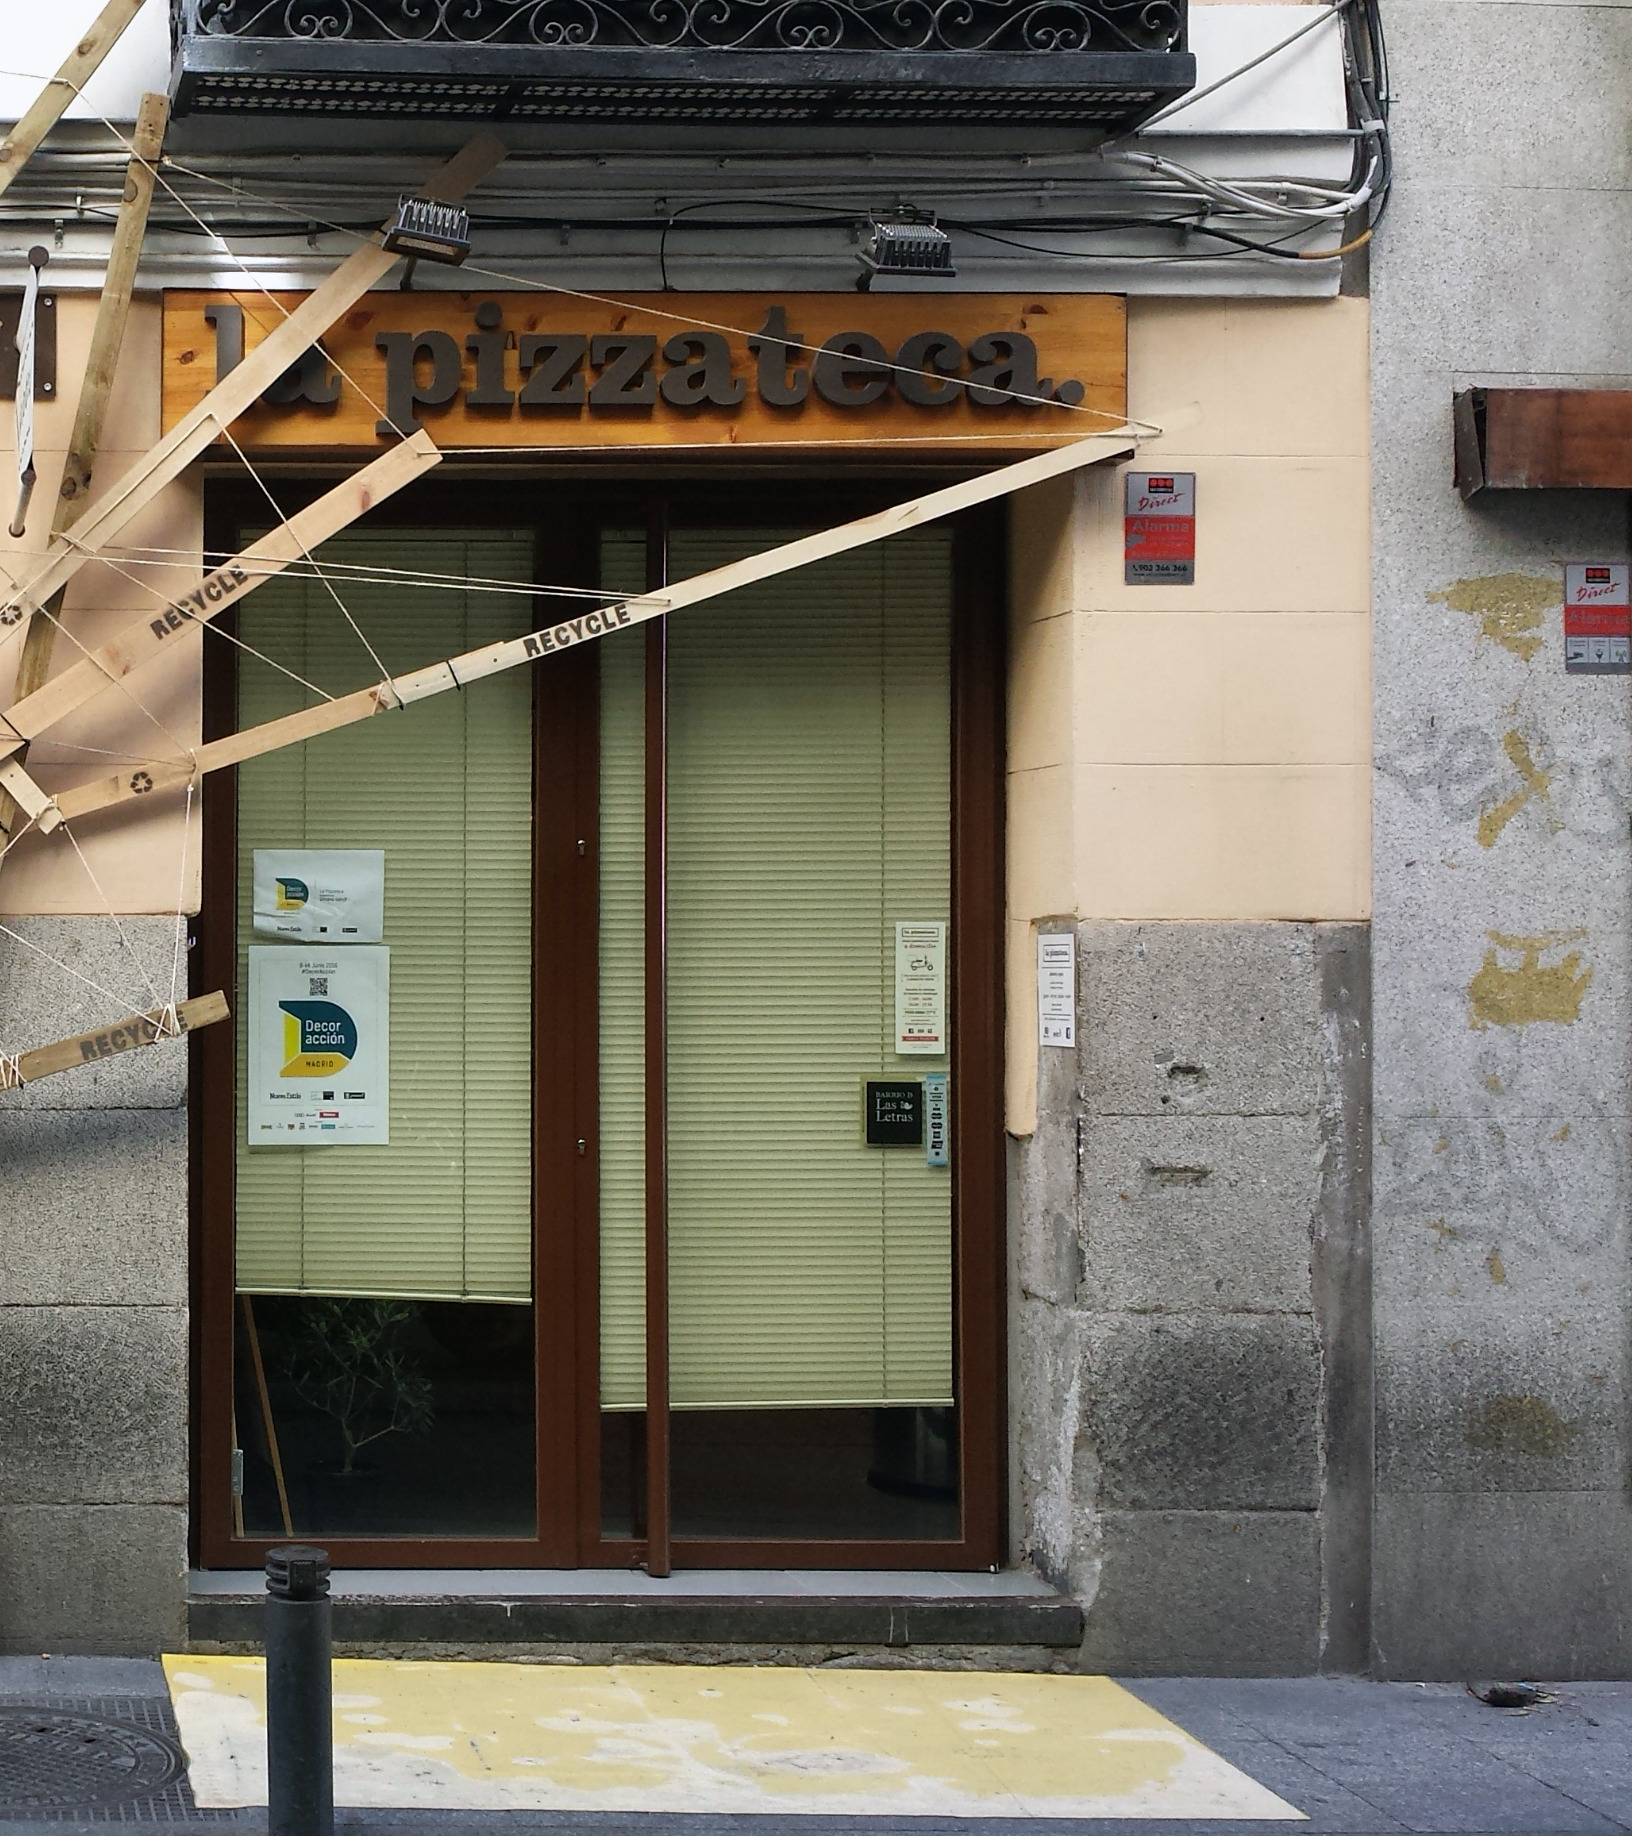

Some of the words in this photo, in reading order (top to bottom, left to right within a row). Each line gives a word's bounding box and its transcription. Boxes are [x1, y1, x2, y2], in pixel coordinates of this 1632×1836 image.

[376, 300, 1085, 434] pizzateca.
[1138, 493, 1185, 511] Direct
[1576, 583, 1621, 601] Direct
[149, 565, 248, 640] RECYCLE
[523, 602, 632, 658] RECYCLE
[305, 1020, 341, 1032] Decor
[305, 1032, 345, 1044] acción
[306, 1060, 334, 1068] MADRID
[876, 1099, 897, 1110] Las
[876, 1110, 914, 1122] Letras
